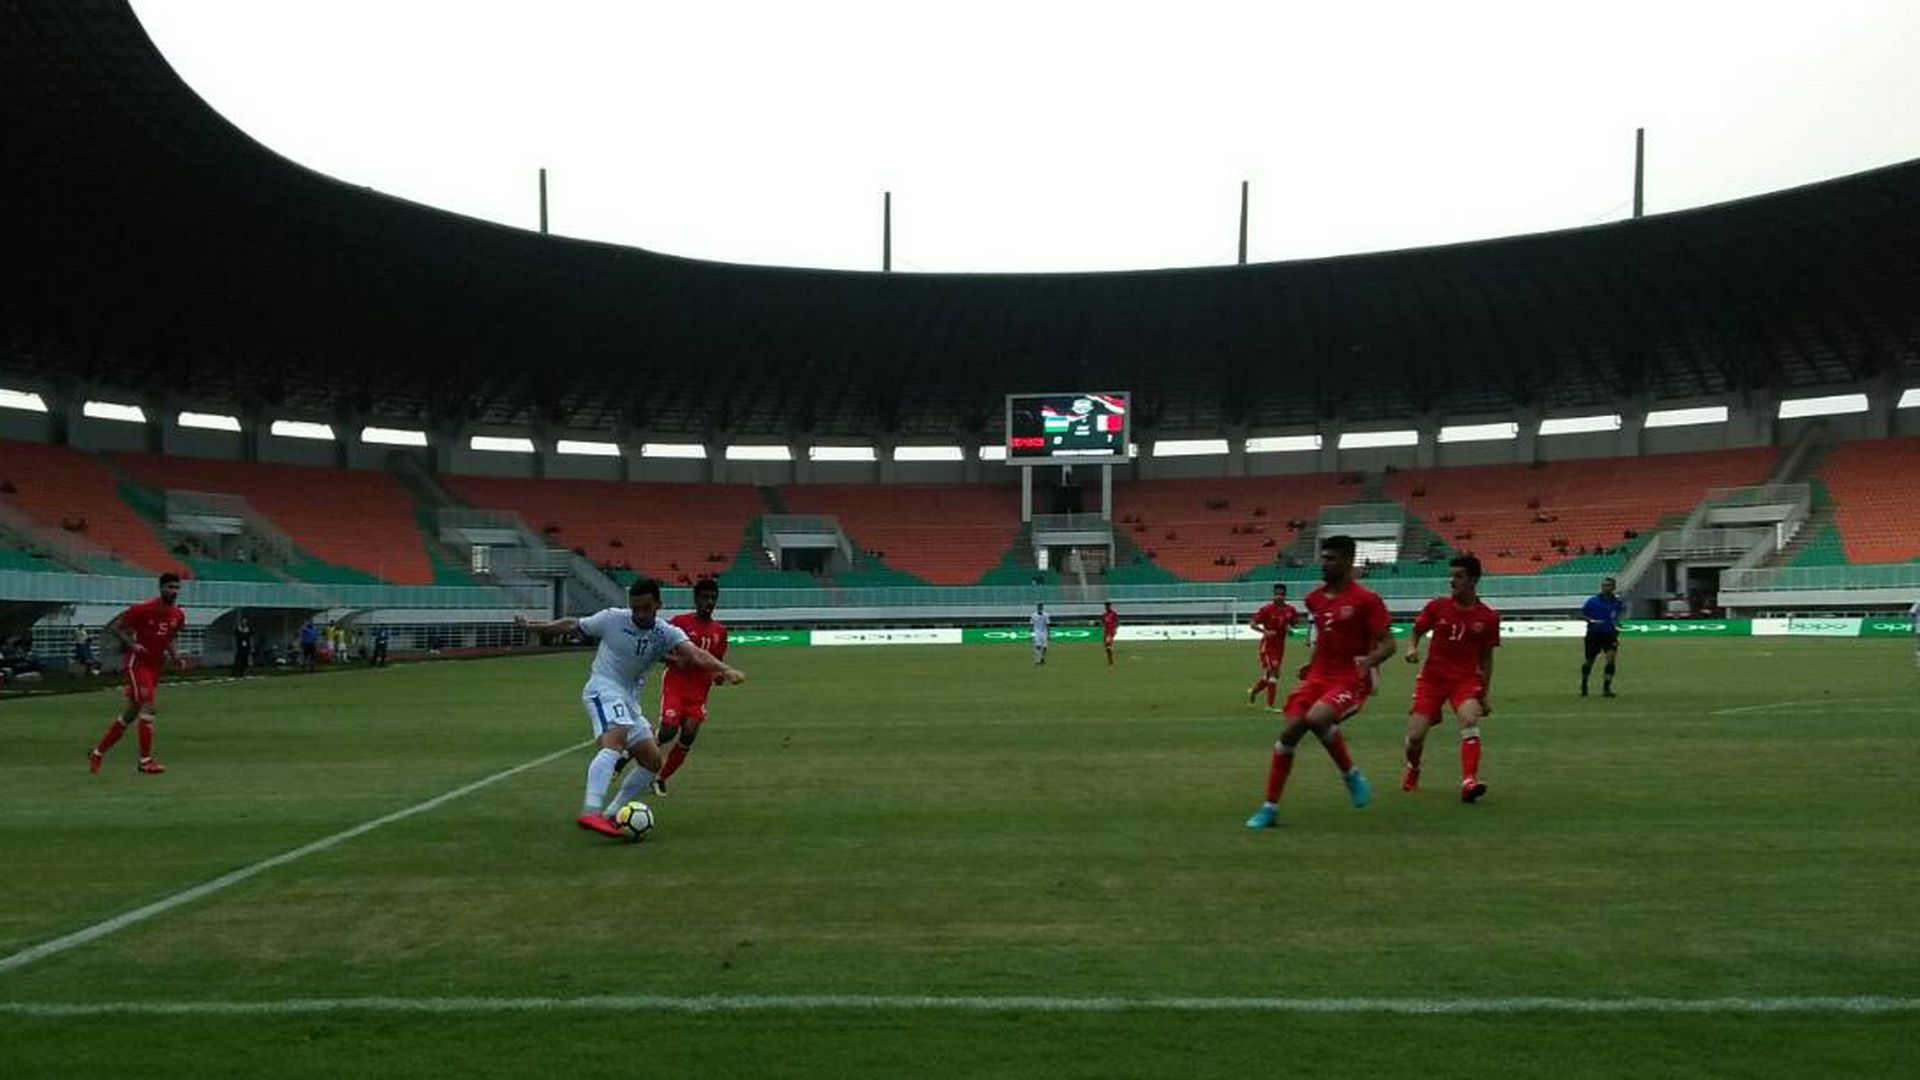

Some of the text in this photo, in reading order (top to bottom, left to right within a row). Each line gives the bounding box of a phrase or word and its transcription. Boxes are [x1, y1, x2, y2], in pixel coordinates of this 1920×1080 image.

[156, 622, 168, 635] 5
[1615, 623, 1727, 633] oppo
[1779, 622, 1848, 631] oppo
[636, 638, 649, 656] 17
[701, 636, 711, 651] 11
[612, 703, 625, 718] 17
